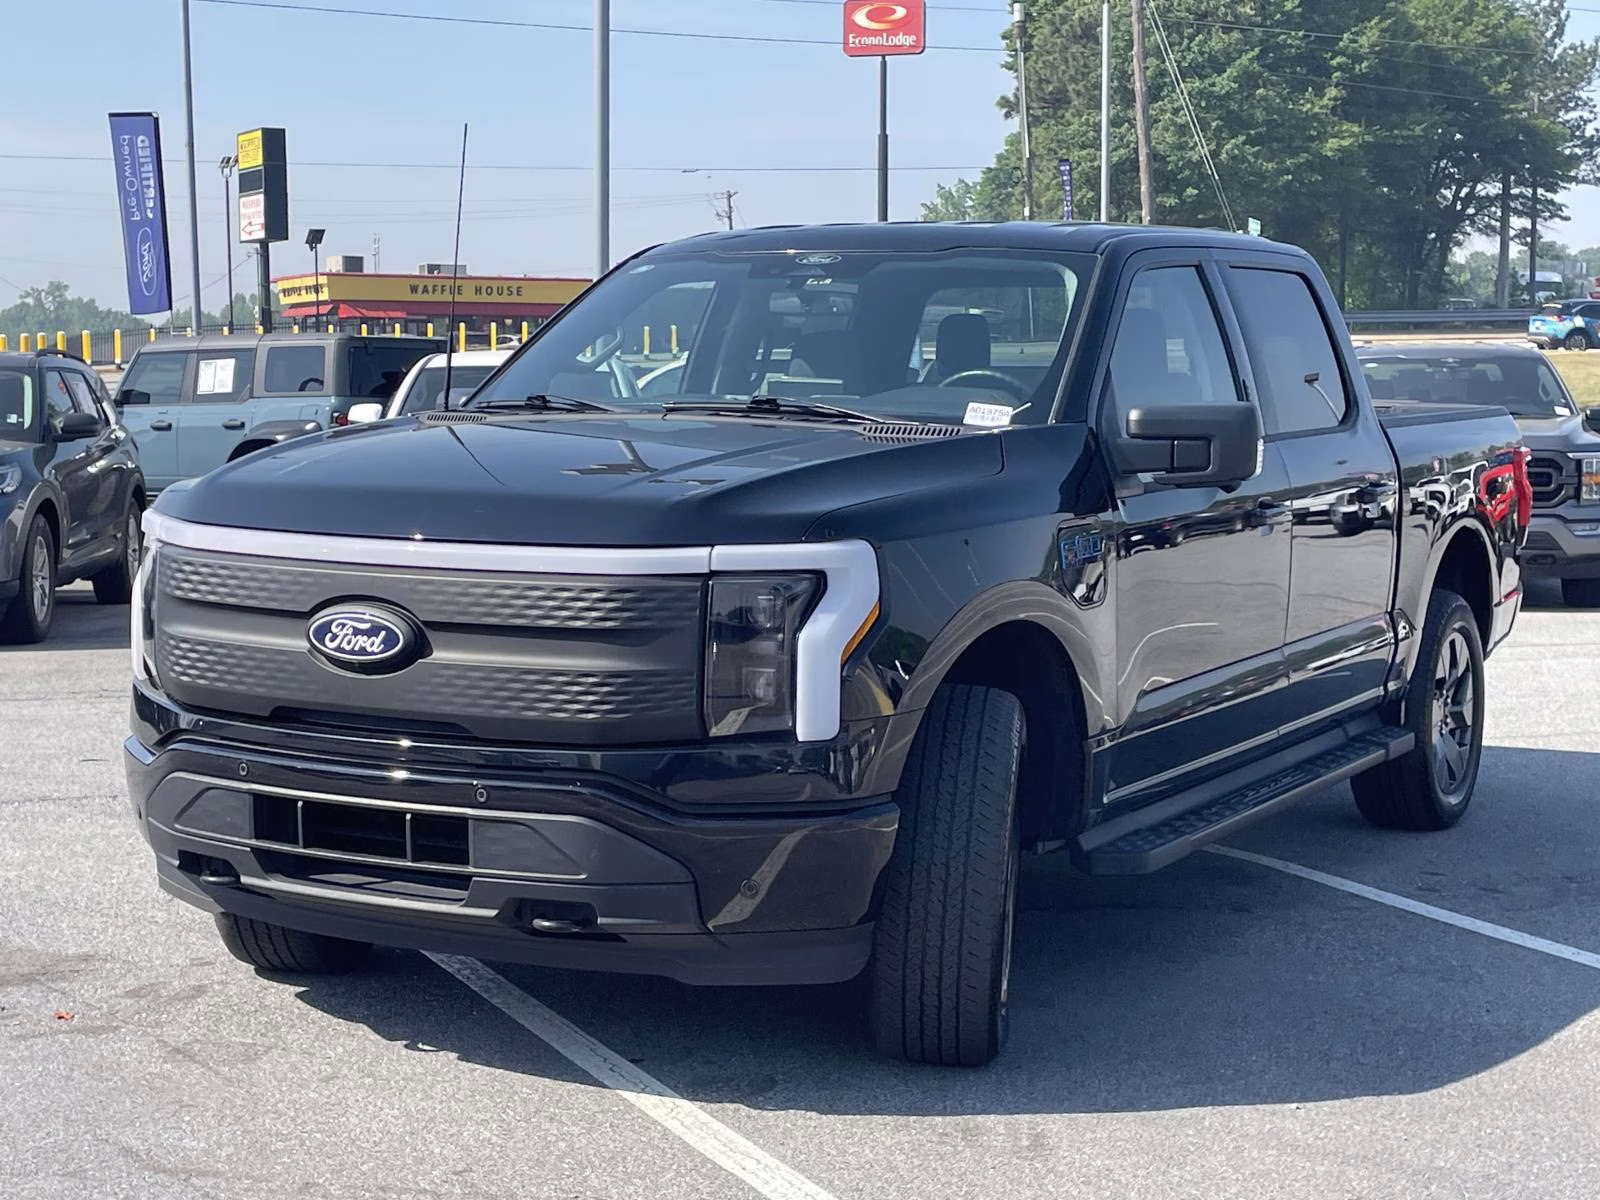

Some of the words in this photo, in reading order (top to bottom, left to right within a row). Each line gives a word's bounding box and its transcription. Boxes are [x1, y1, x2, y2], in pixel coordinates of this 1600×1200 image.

[409, 283, 464, 295] WAFFLE
[474, 285, 523, 296] HOUSE
[324, 618, 386, 653] Ford
